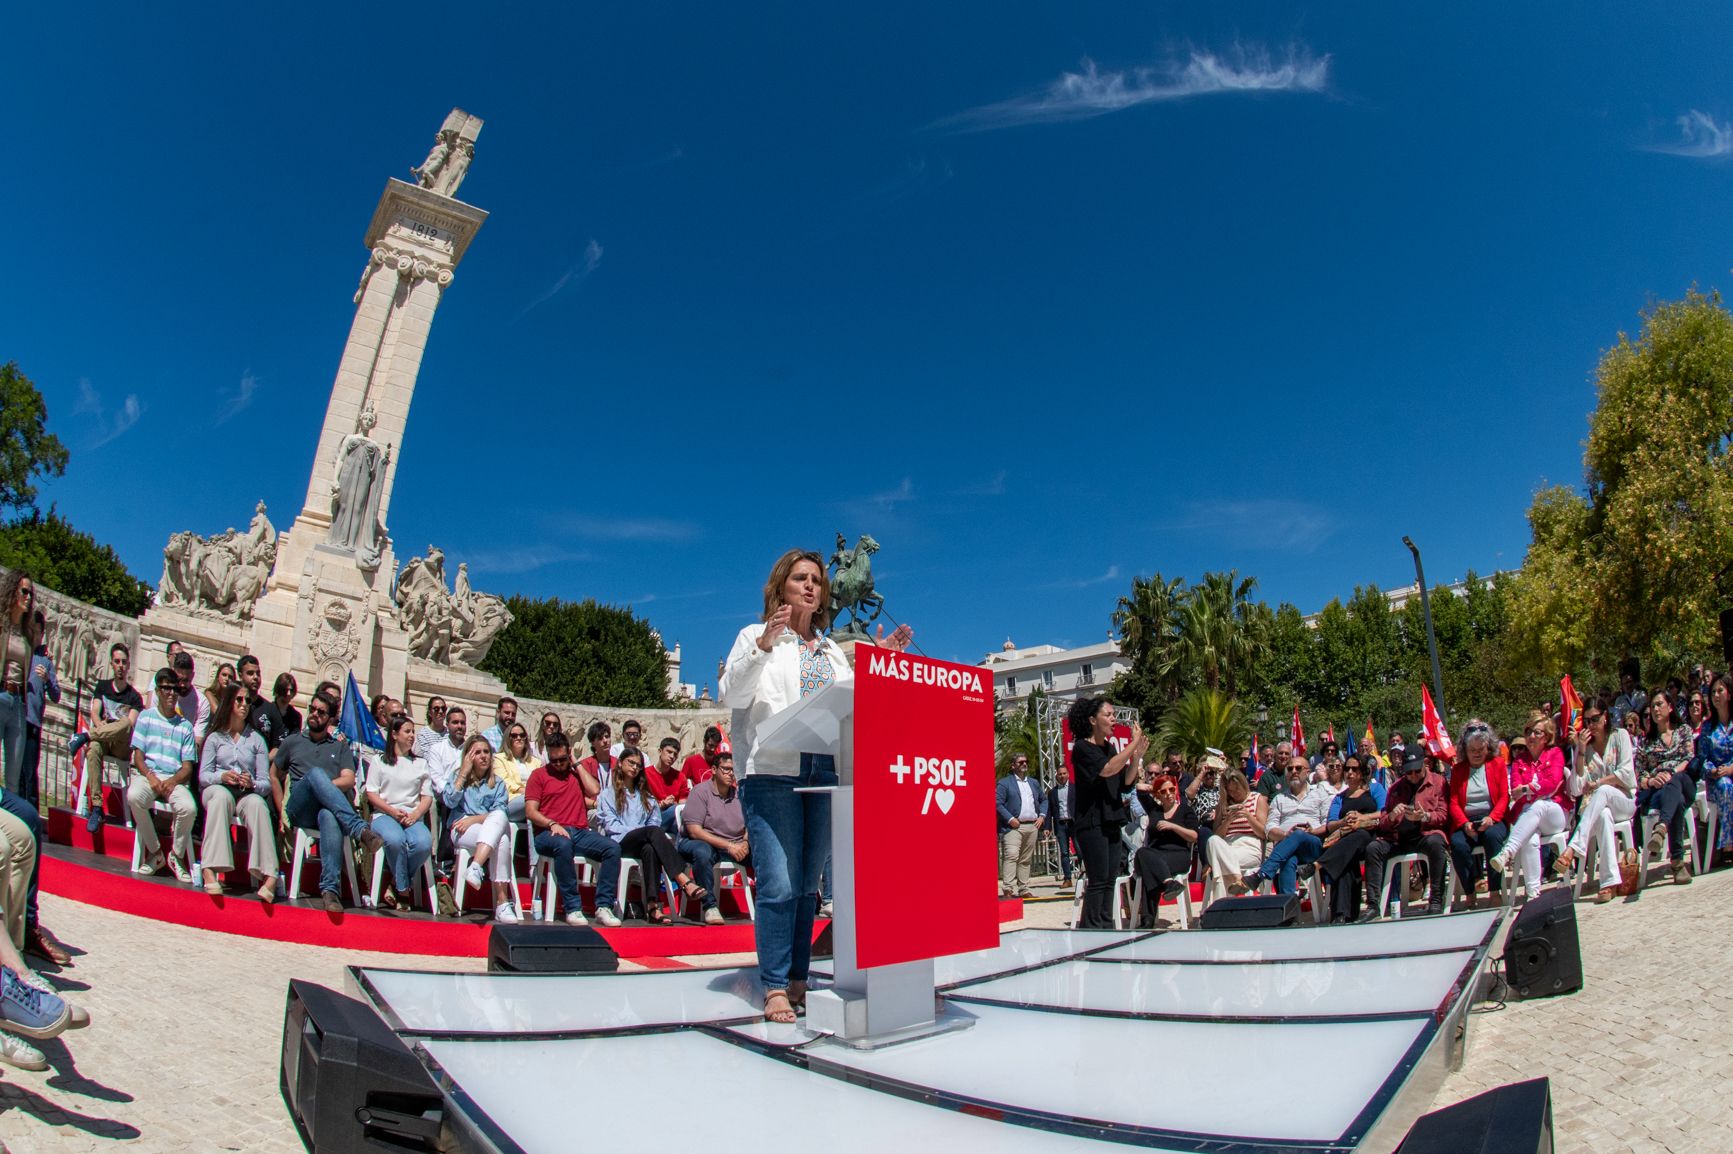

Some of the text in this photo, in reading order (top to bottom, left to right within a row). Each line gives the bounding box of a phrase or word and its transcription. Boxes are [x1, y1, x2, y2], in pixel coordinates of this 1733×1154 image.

[410, 222, 438, 241] 1812
[869, 652, 983, 693] MÁS EUROPA
